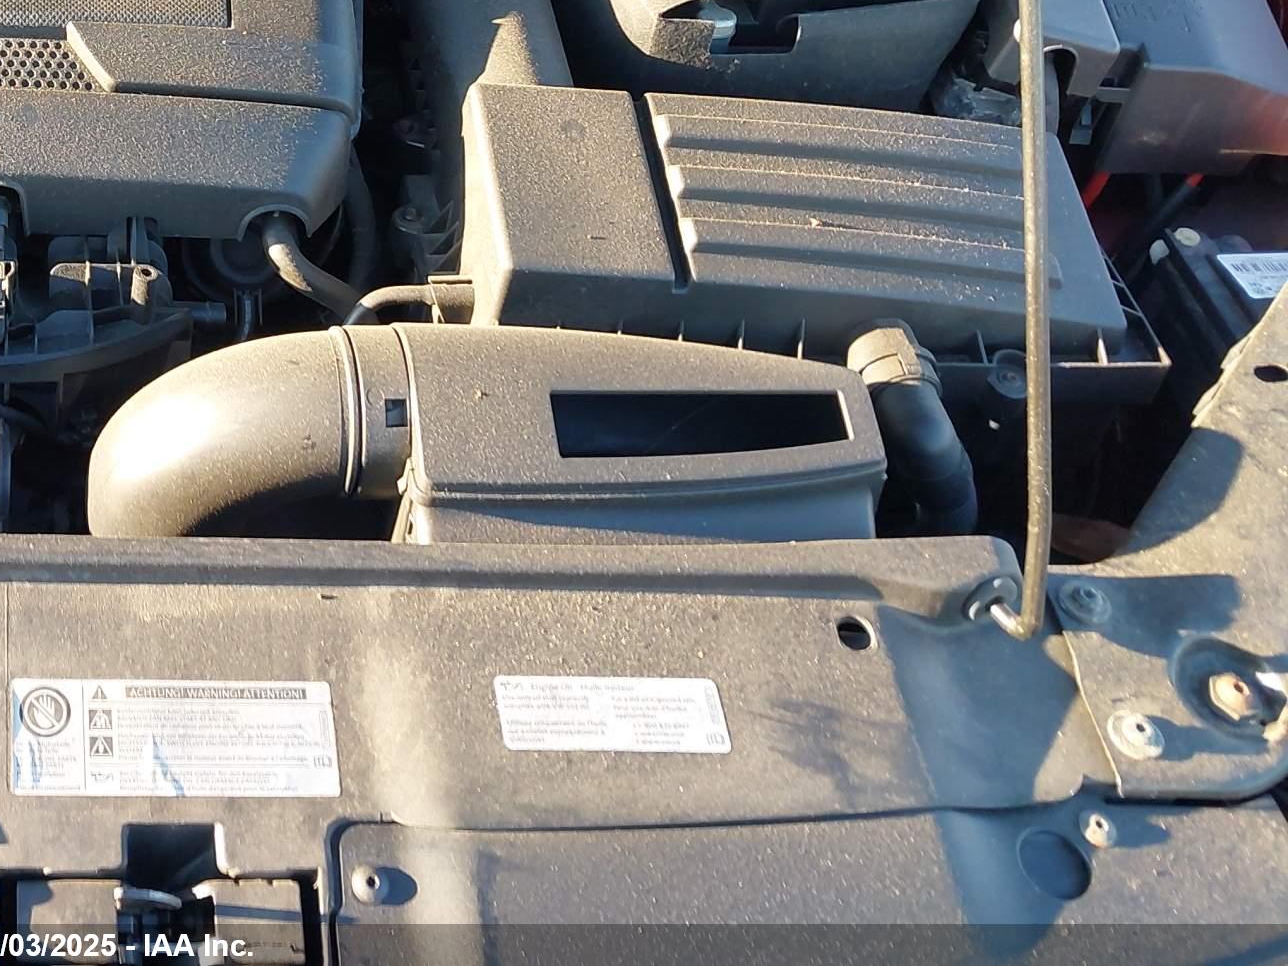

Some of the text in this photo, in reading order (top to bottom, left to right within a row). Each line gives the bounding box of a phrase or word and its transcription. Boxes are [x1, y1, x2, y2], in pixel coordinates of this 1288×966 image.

[130, 687, 304, 700] ACHTUNG! WARNING! ATTENTION!
